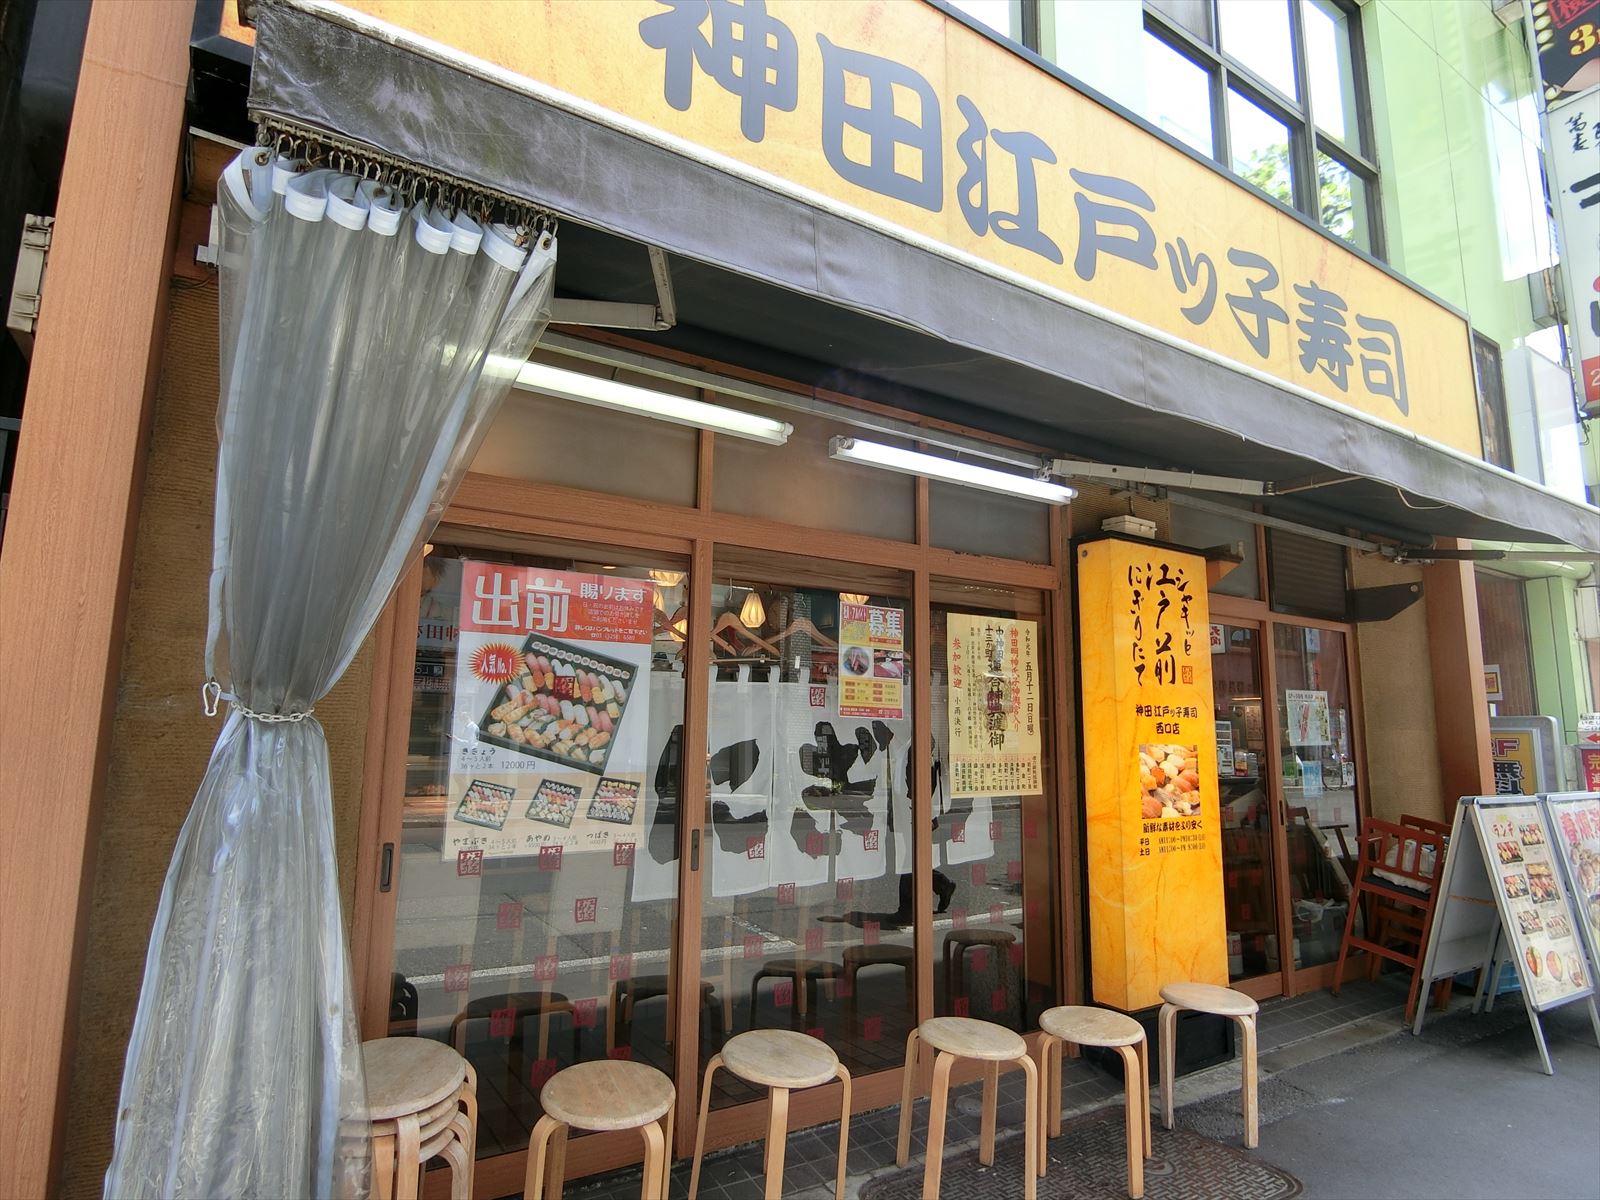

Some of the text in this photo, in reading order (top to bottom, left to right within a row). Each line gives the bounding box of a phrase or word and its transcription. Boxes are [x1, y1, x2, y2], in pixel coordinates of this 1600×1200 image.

[472, 573, 647, 633] 出前 賜ります
[869, 608, 902, 637] 募集
[1128, 564, 1146, 687] にぎりたて
[1146, 562, 1176, 686] 江戸前
[953, 636, 962, 689] 参加歓迎
[1156, 722, 1180, 735] 西口店
[501, 761, 536, 769] 12000円
